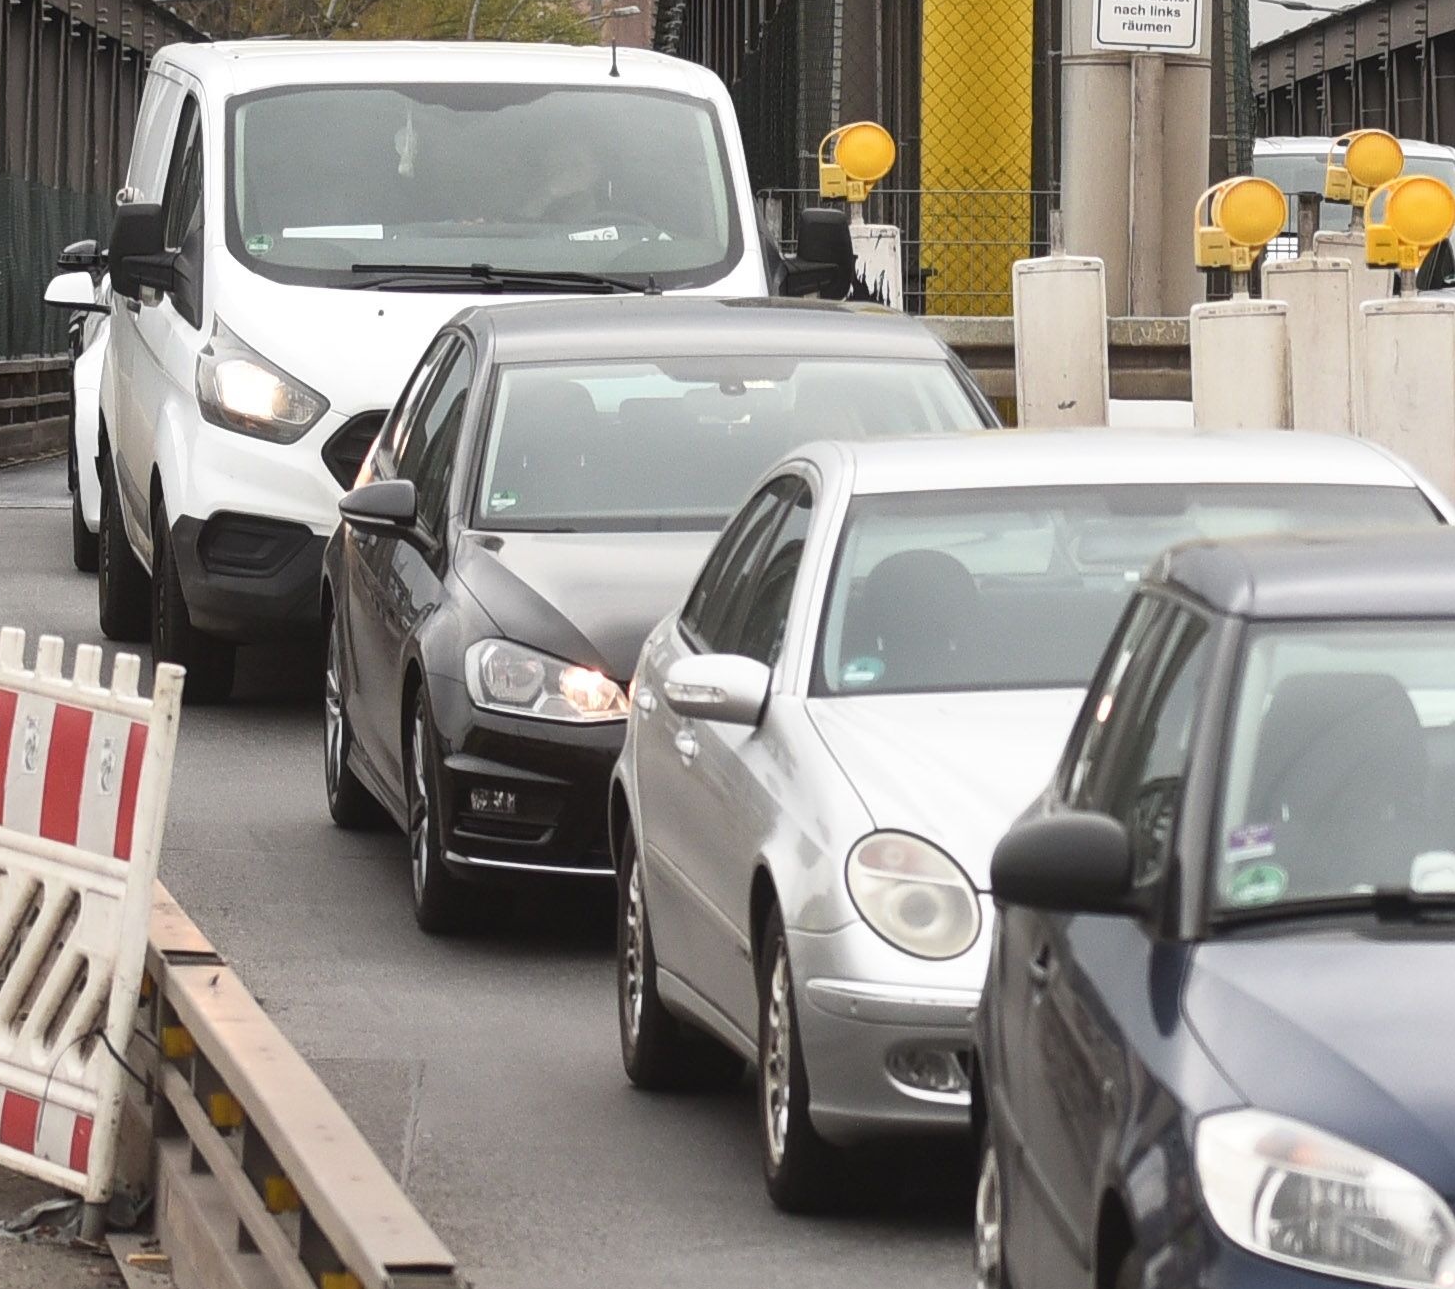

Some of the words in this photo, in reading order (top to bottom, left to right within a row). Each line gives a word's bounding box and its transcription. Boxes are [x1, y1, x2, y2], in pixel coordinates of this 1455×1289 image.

[1113, 4, 1146, 16] nach
[1150, 5, 1181, 18] links
[1122, 19, 1172, 33] räumen
